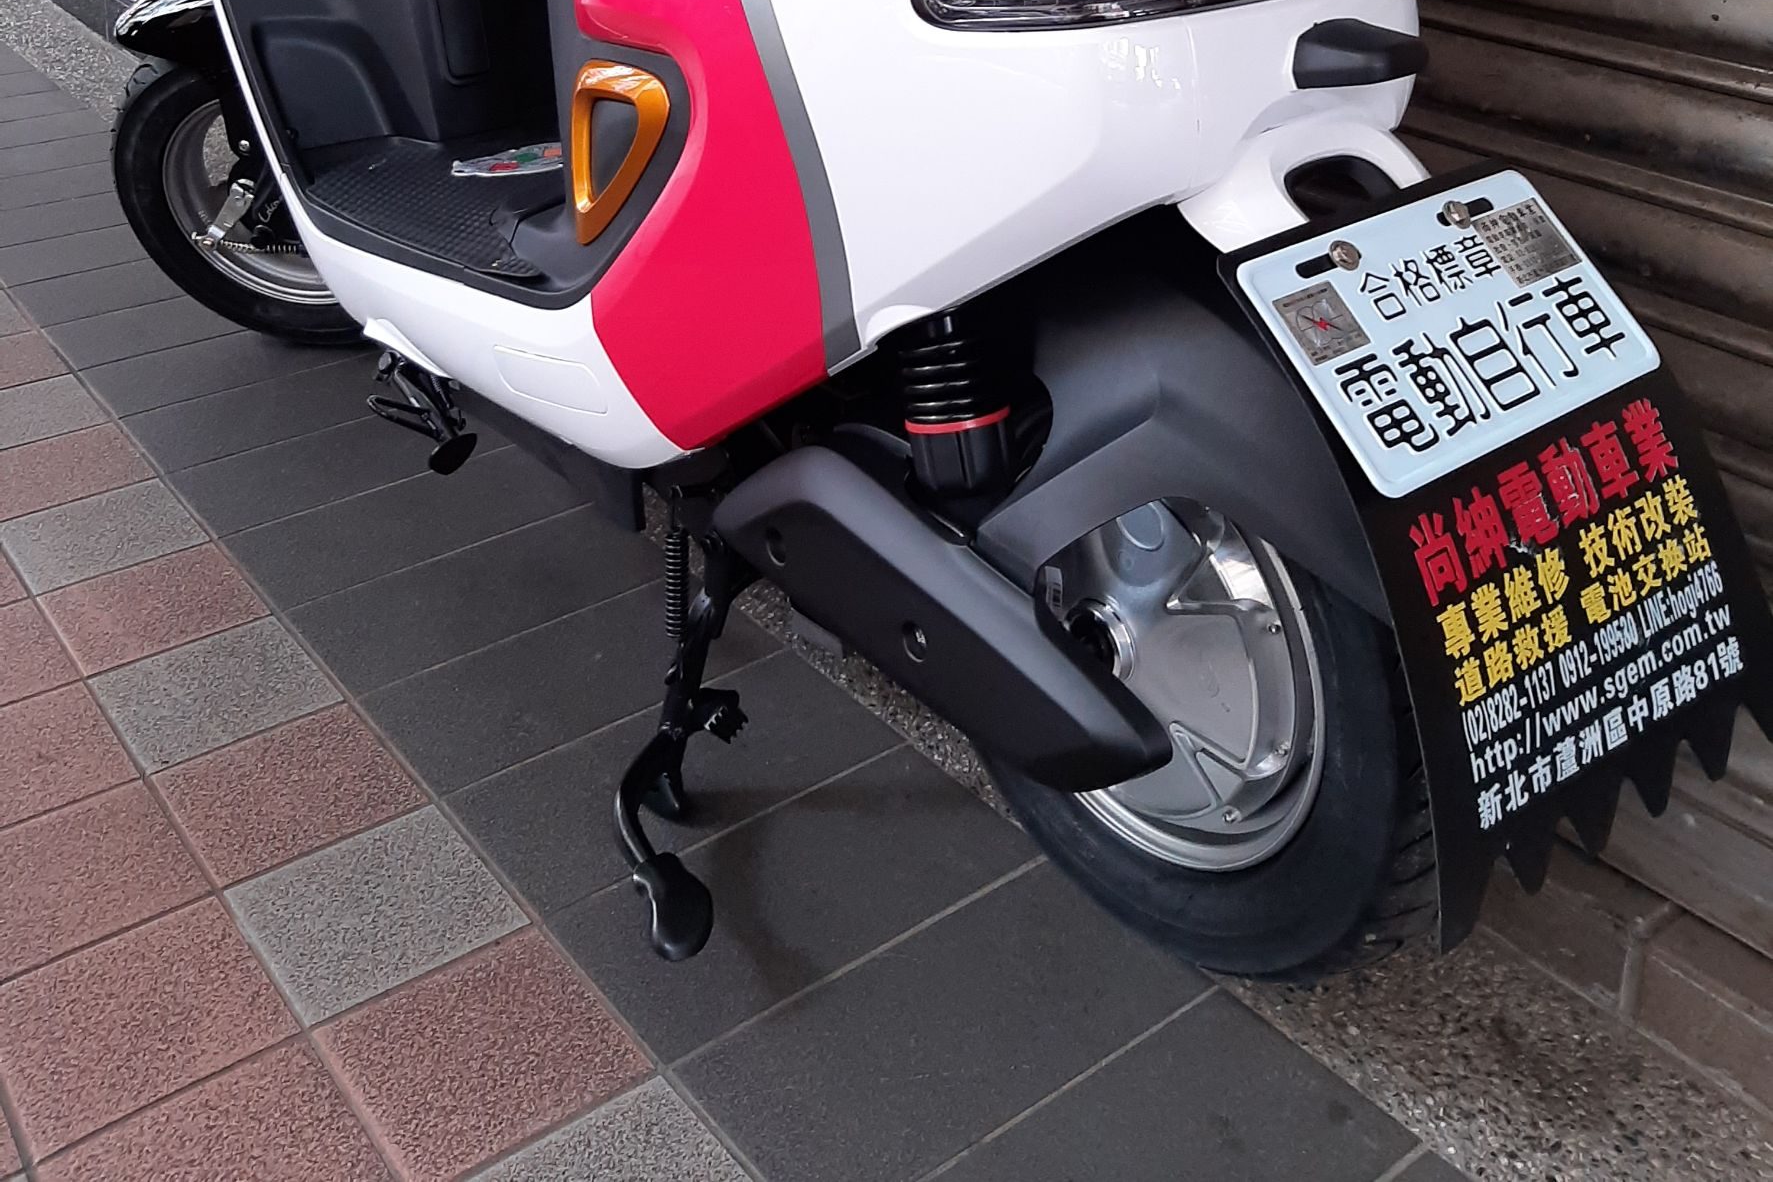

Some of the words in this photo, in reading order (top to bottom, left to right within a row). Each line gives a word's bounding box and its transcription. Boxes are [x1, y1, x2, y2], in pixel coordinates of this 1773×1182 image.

[1334, 275, 1627, 454] 電動自行車
[1359, 236, 1502, 321] 合格標章
[1408, 397, 1679, 607] 尚紳電動車業
[1435, 547, 1571, 660] 專業維修
[1578, 474, 1699, 578] 技術改裝
[1454, 604, 1573, 707] 道路救援
[1580, 525, 1712, 626] 電池交換站
[1462, 663, 1556, 753] (02)8282-1137
[1637, 560, 1724, 640] LINE:hogi4766
[1471, 603, 1733, 783] http://www.sgem.com.tw
[1477, 635, 1744, 832] 新北市蘆洲區中原路81號
